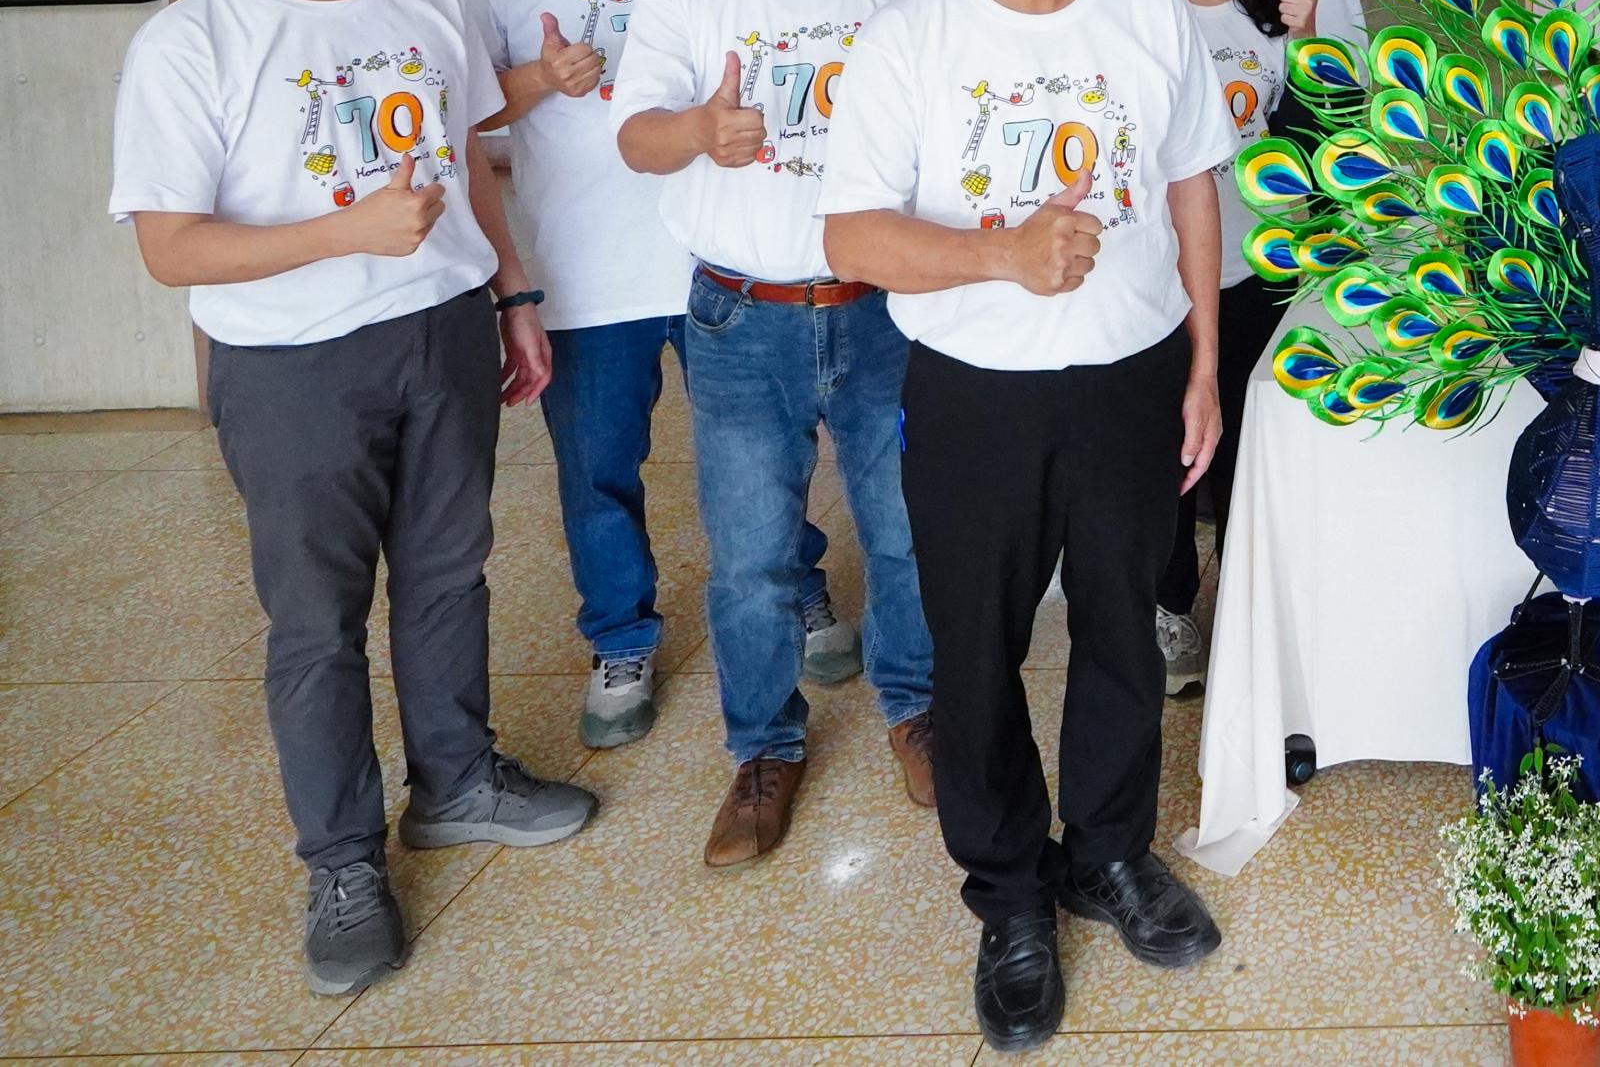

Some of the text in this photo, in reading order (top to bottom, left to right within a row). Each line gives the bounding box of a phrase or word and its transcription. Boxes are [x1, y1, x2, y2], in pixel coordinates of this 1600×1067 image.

[780, 129, 806, 139] Home
[355, 166, 387, 179] Home
[1010, 196, 1041, 207] Home
